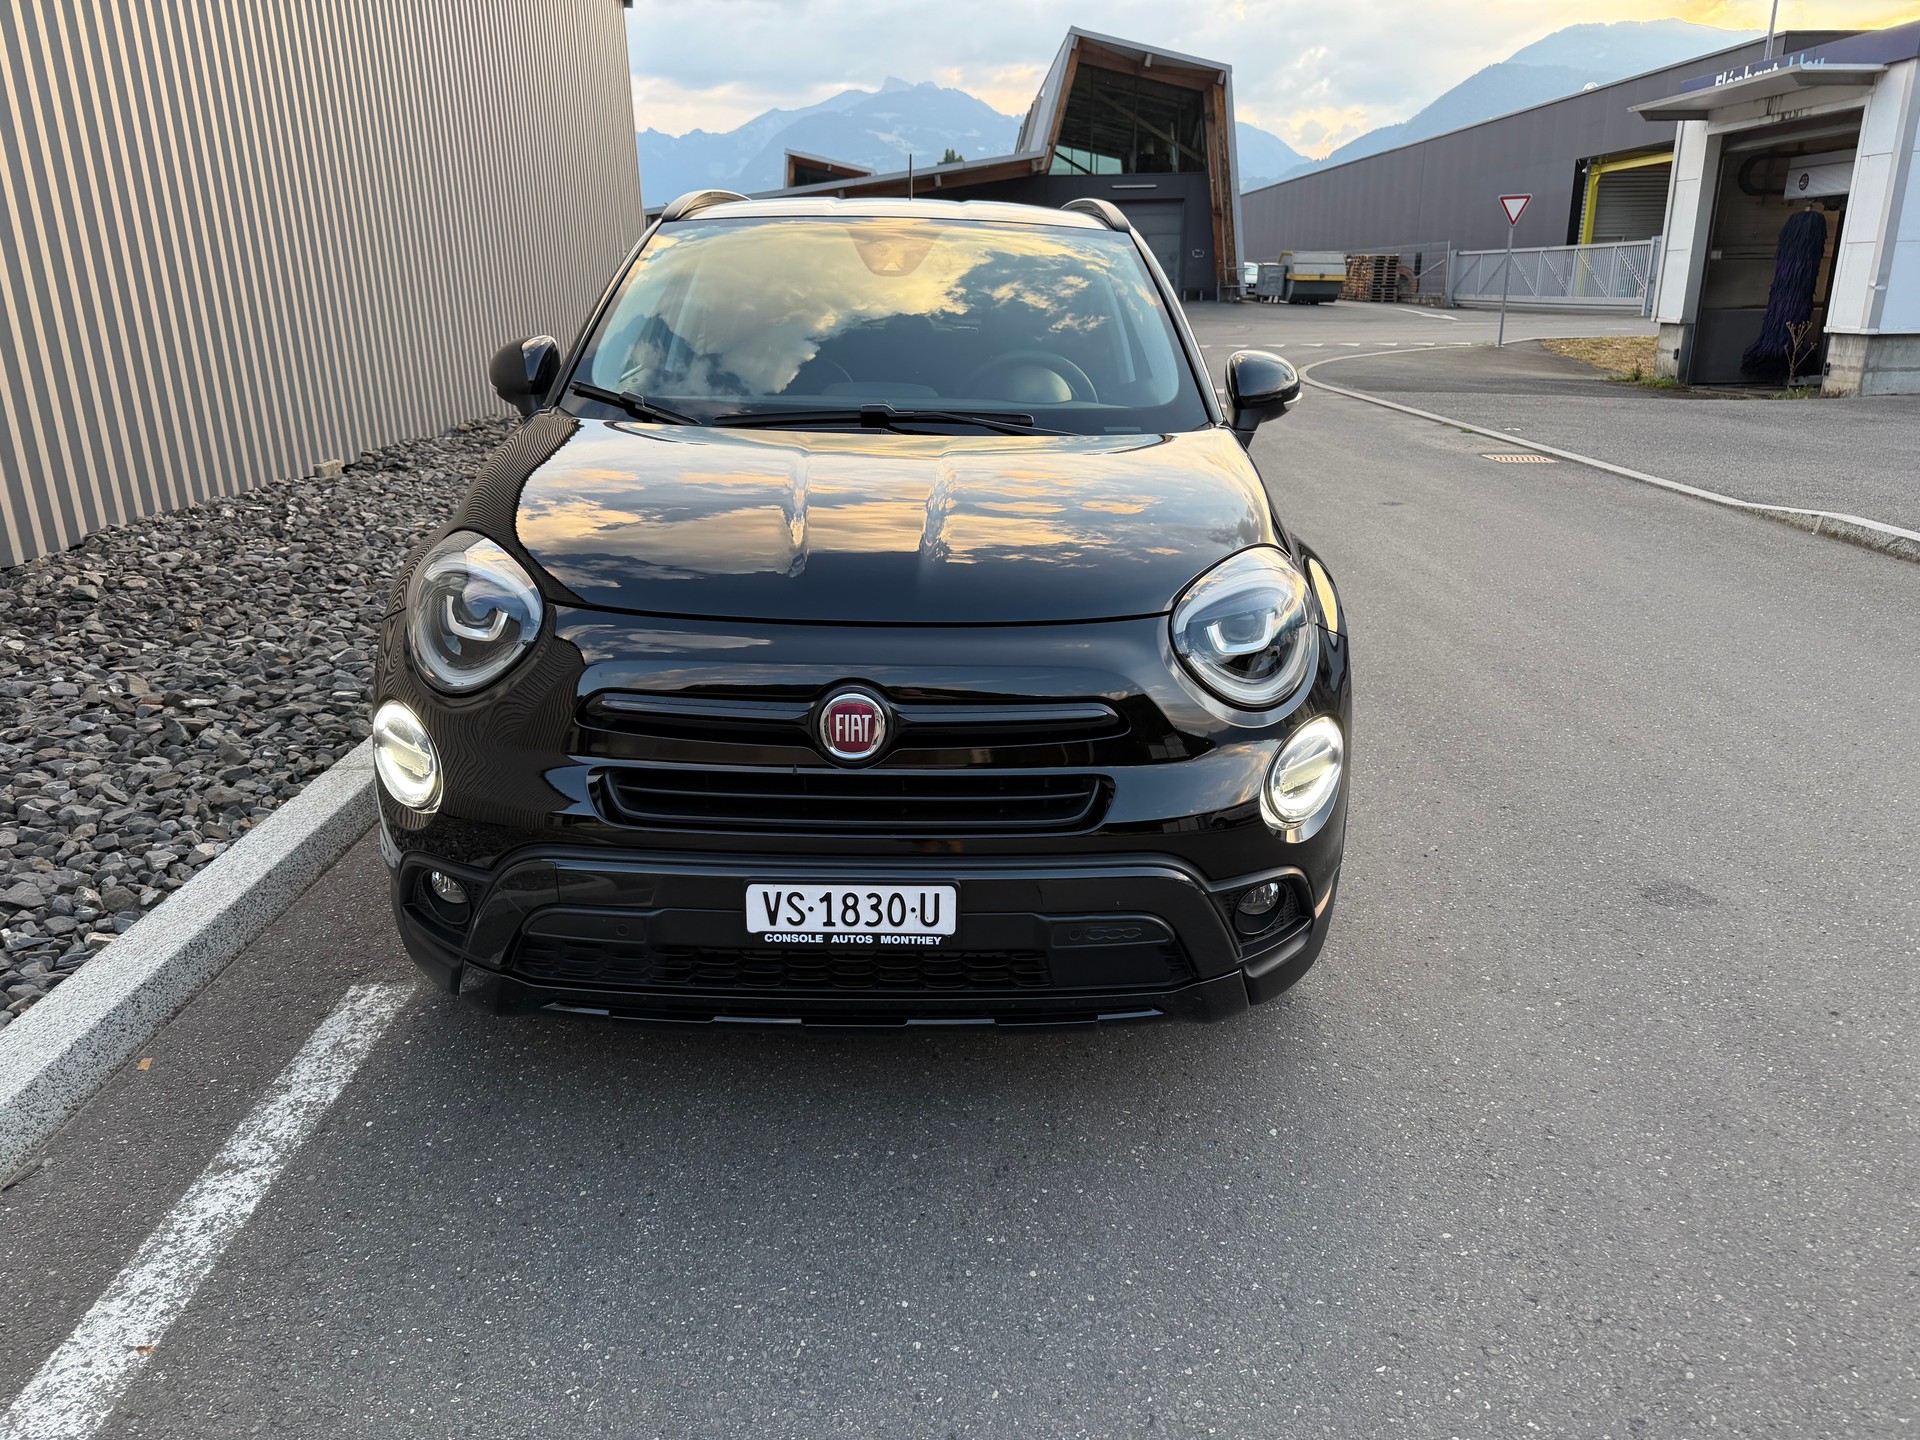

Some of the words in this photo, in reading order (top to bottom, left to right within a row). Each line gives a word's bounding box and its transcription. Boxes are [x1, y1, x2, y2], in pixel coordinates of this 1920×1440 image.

[835, 714, 872, 742] FIAT
[764, 933, 824, 943] CONSOLE
[831, 934, 873, 944] AUTOS
[880, 935, 942, 945] MONTHEY
